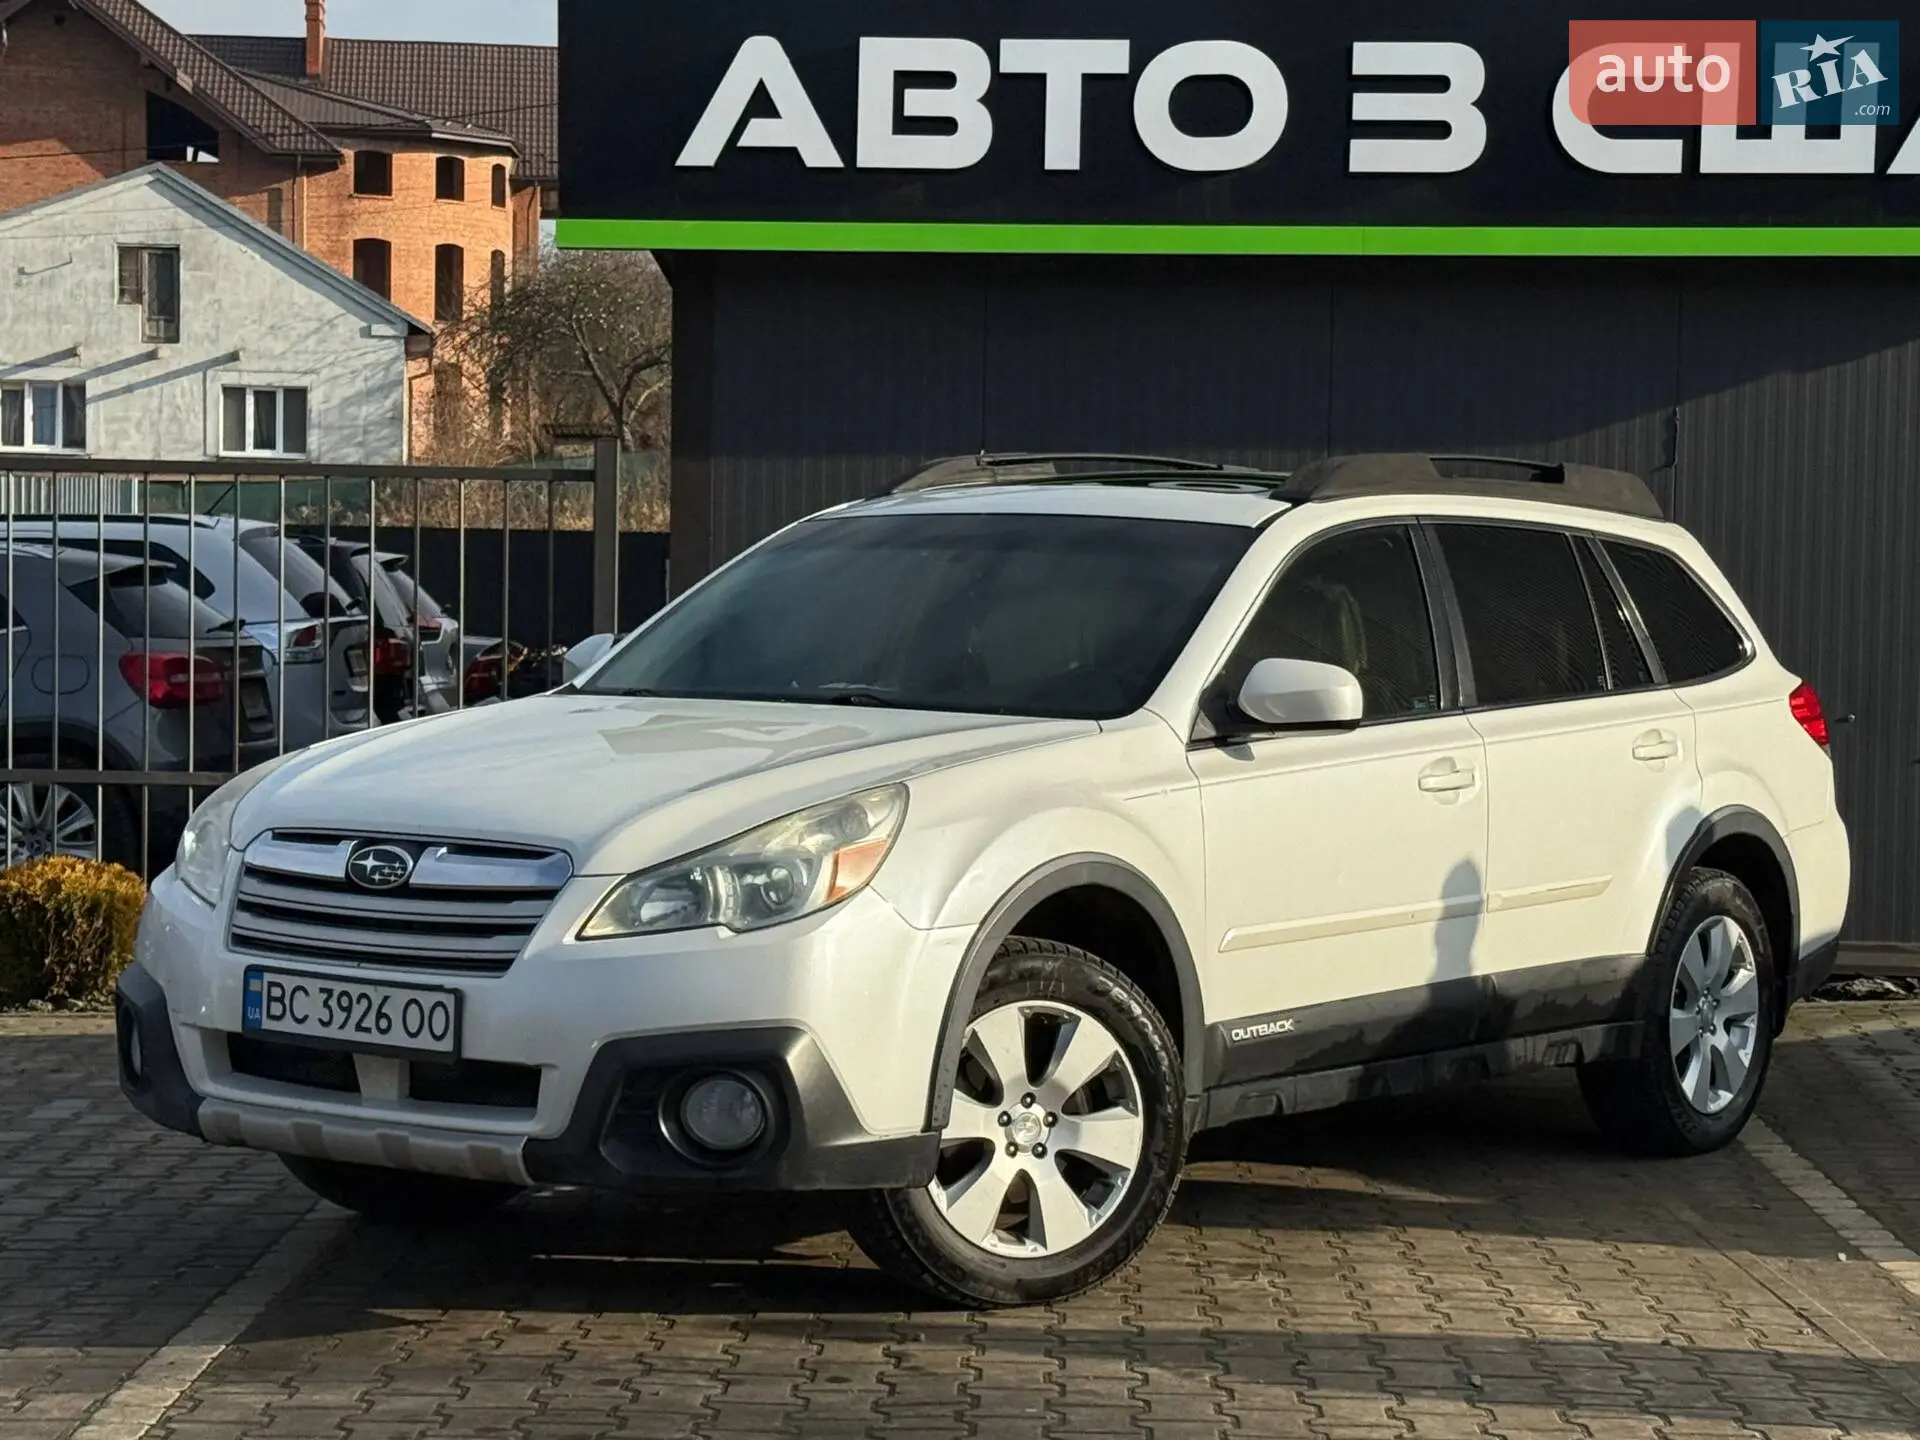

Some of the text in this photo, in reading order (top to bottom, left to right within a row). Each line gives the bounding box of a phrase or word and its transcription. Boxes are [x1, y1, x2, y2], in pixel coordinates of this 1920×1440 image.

[674, 35, 1289, 172] АВТО
[1552, 42, 1920, 174] СШ
[247, 1006, 261, 1019] UA
[265, 980, 311, 1025] BC
[317, 987, 393, 1036] 3926
[1231, 1018, 1295, 1041] OUTBACK
